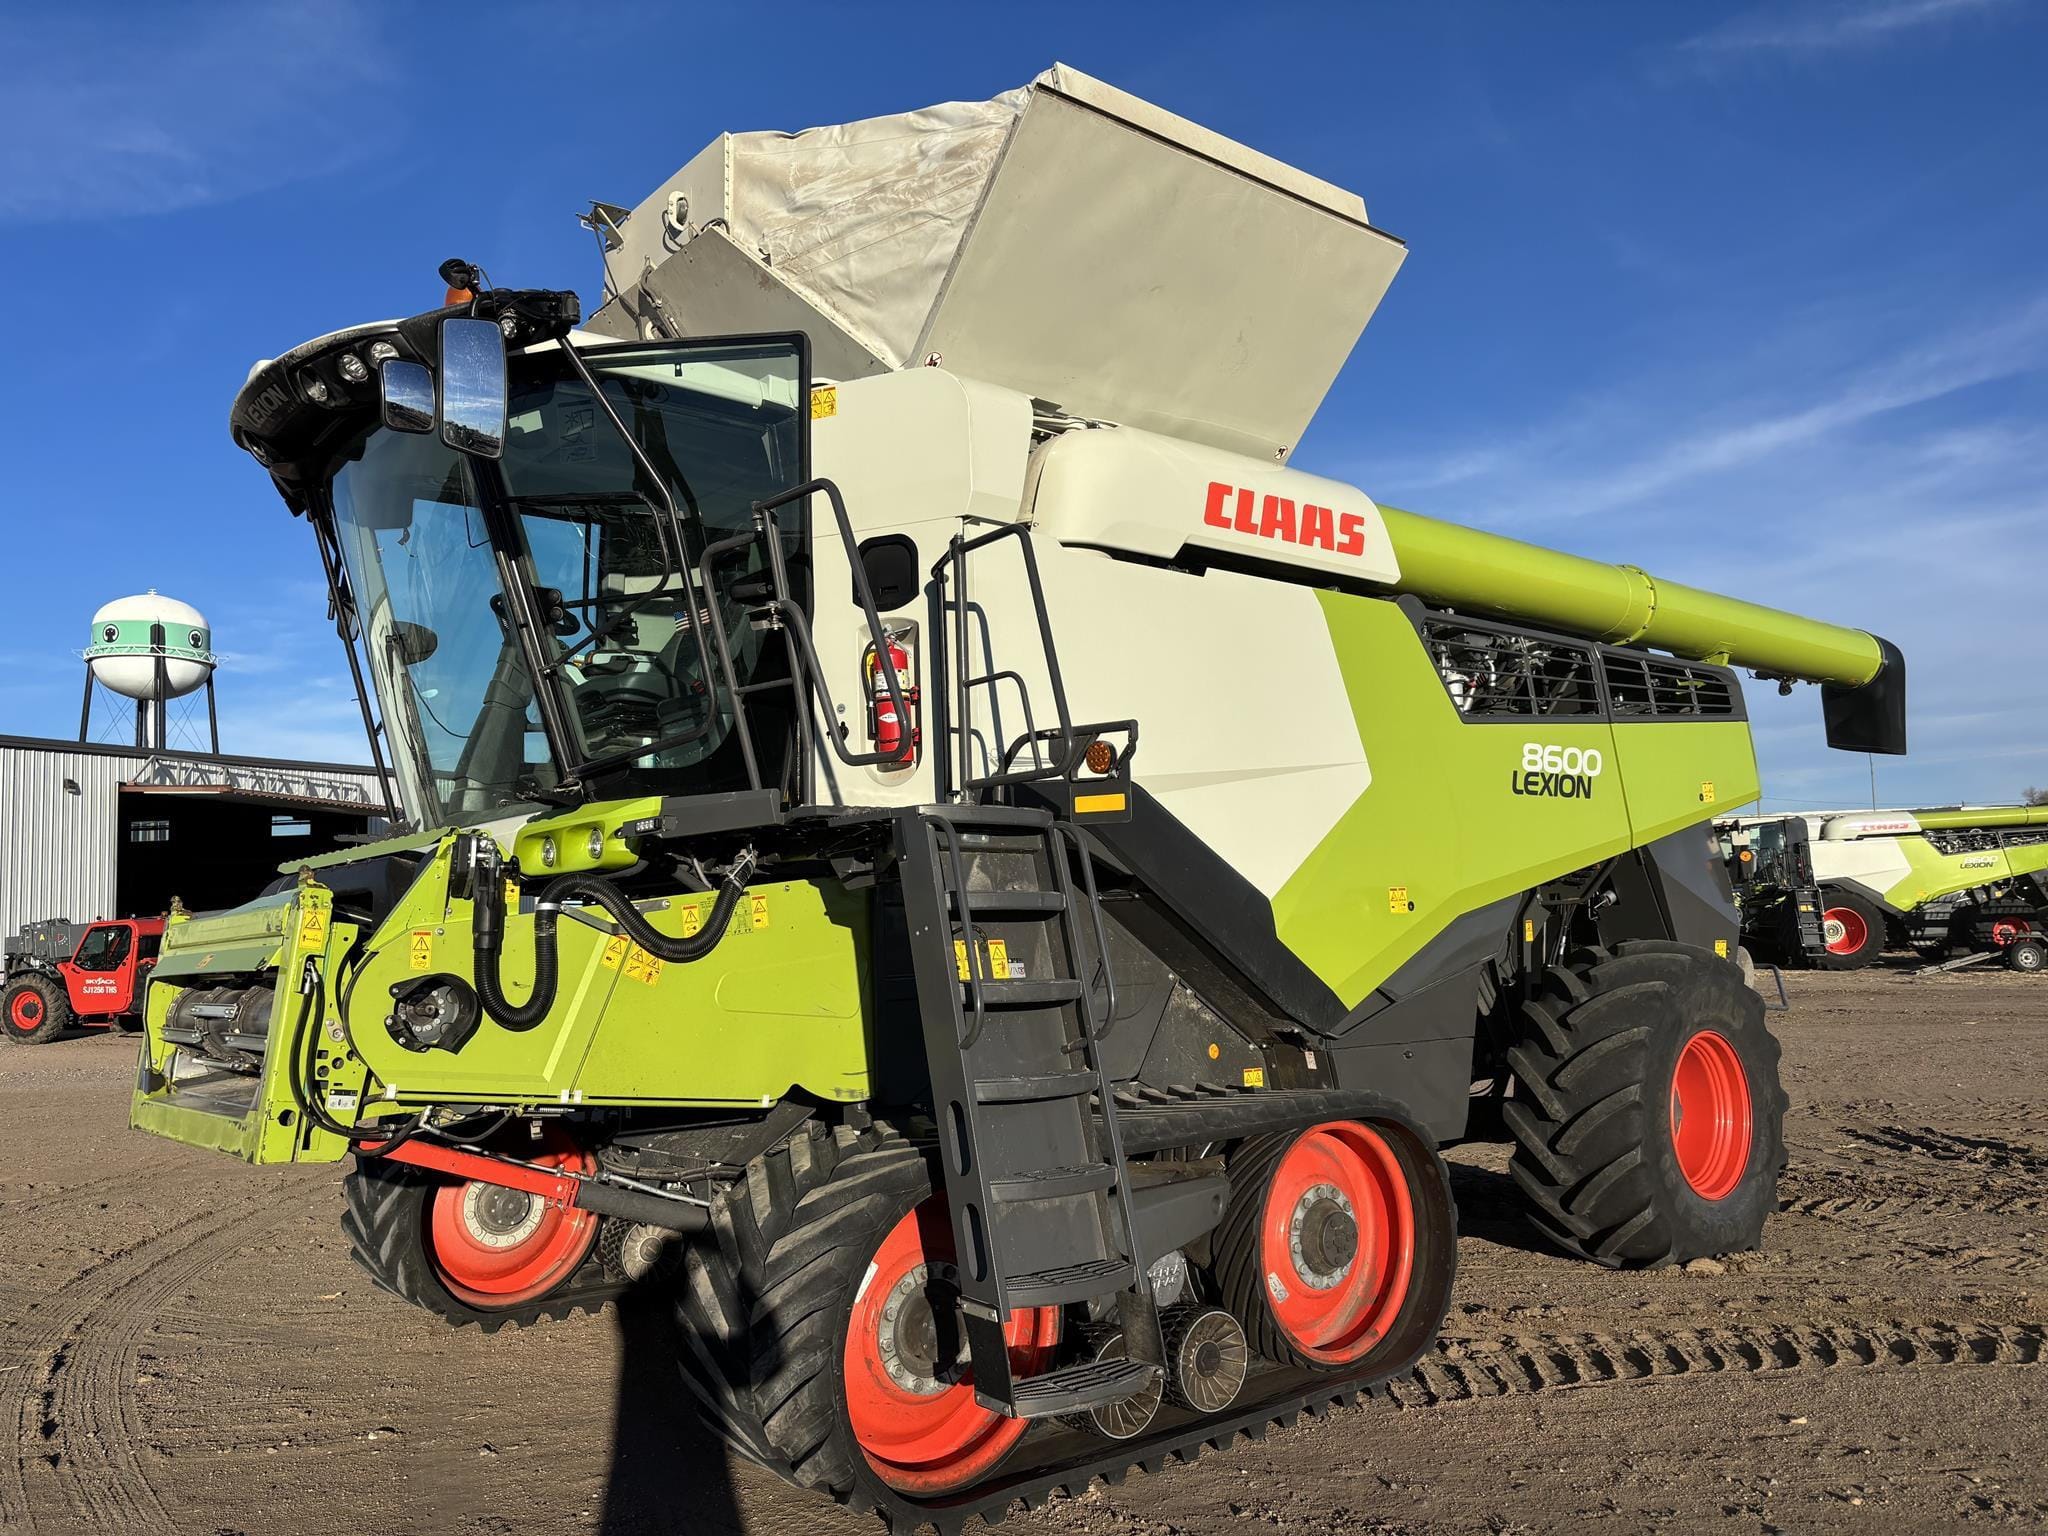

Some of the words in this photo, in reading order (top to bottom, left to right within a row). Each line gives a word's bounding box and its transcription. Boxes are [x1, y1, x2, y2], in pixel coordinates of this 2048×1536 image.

[244, 383, 288, 428] LEXION
[1203, 481, 1365, 557] CLAAS
[1521, 742, 1602, 777] 8600
[1511, 770, 1592, 799] LEXION
[1960, 861, 1994, 869] LEXION
